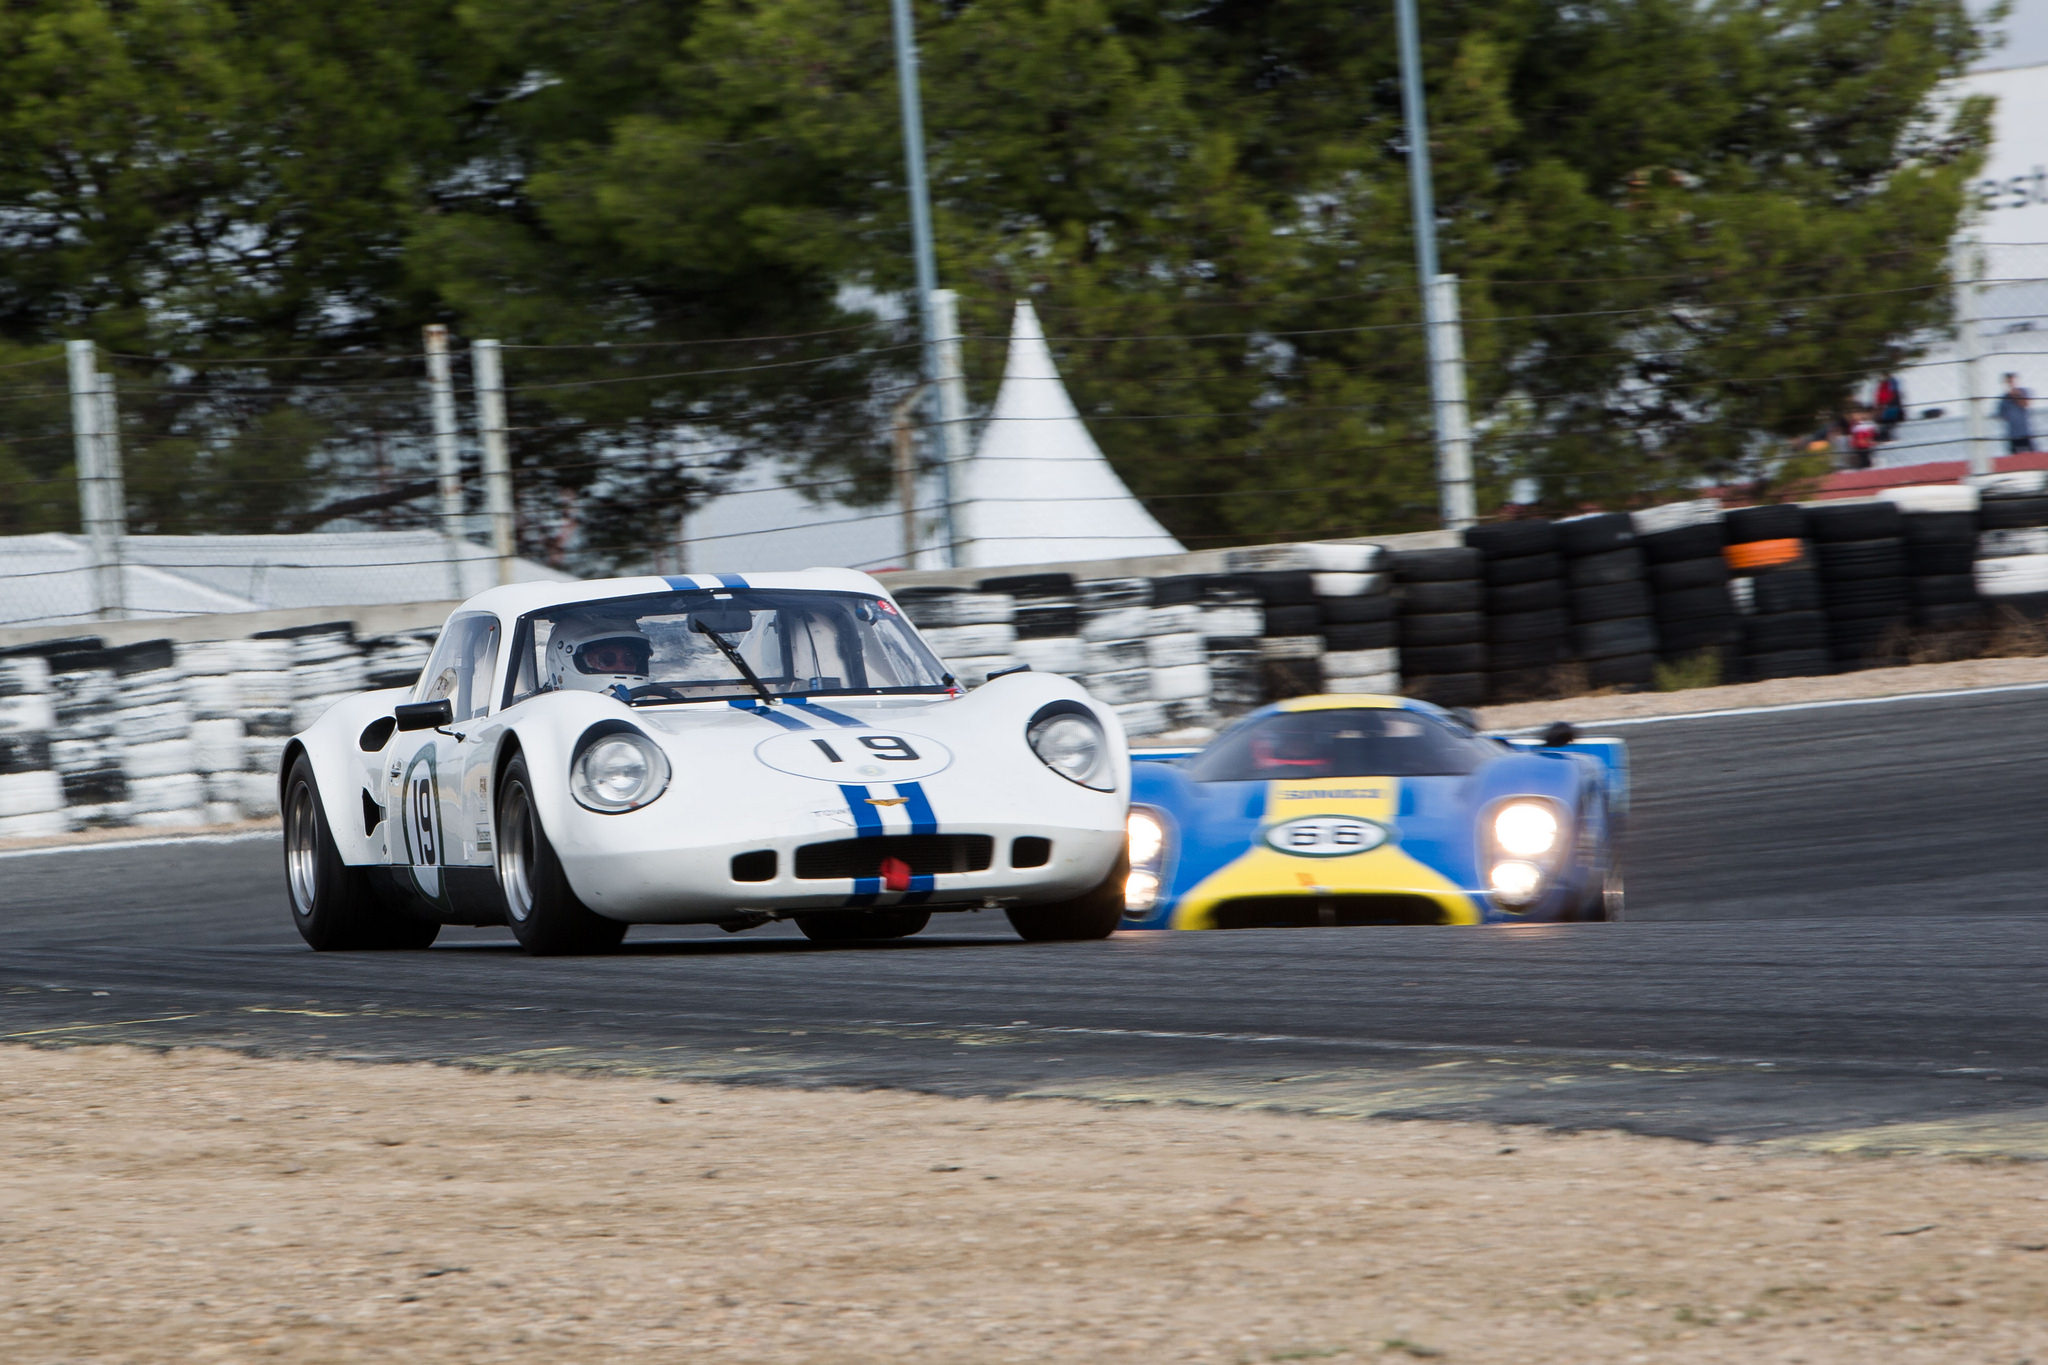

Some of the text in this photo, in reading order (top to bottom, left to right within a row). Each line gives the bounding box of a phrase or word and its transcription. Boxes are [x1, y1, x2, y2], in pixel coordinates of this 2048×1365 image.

[811, 735, 920, 762] 19
[413, 778, 436, 865] 19
[1288, 825, 1363, 846] 66
